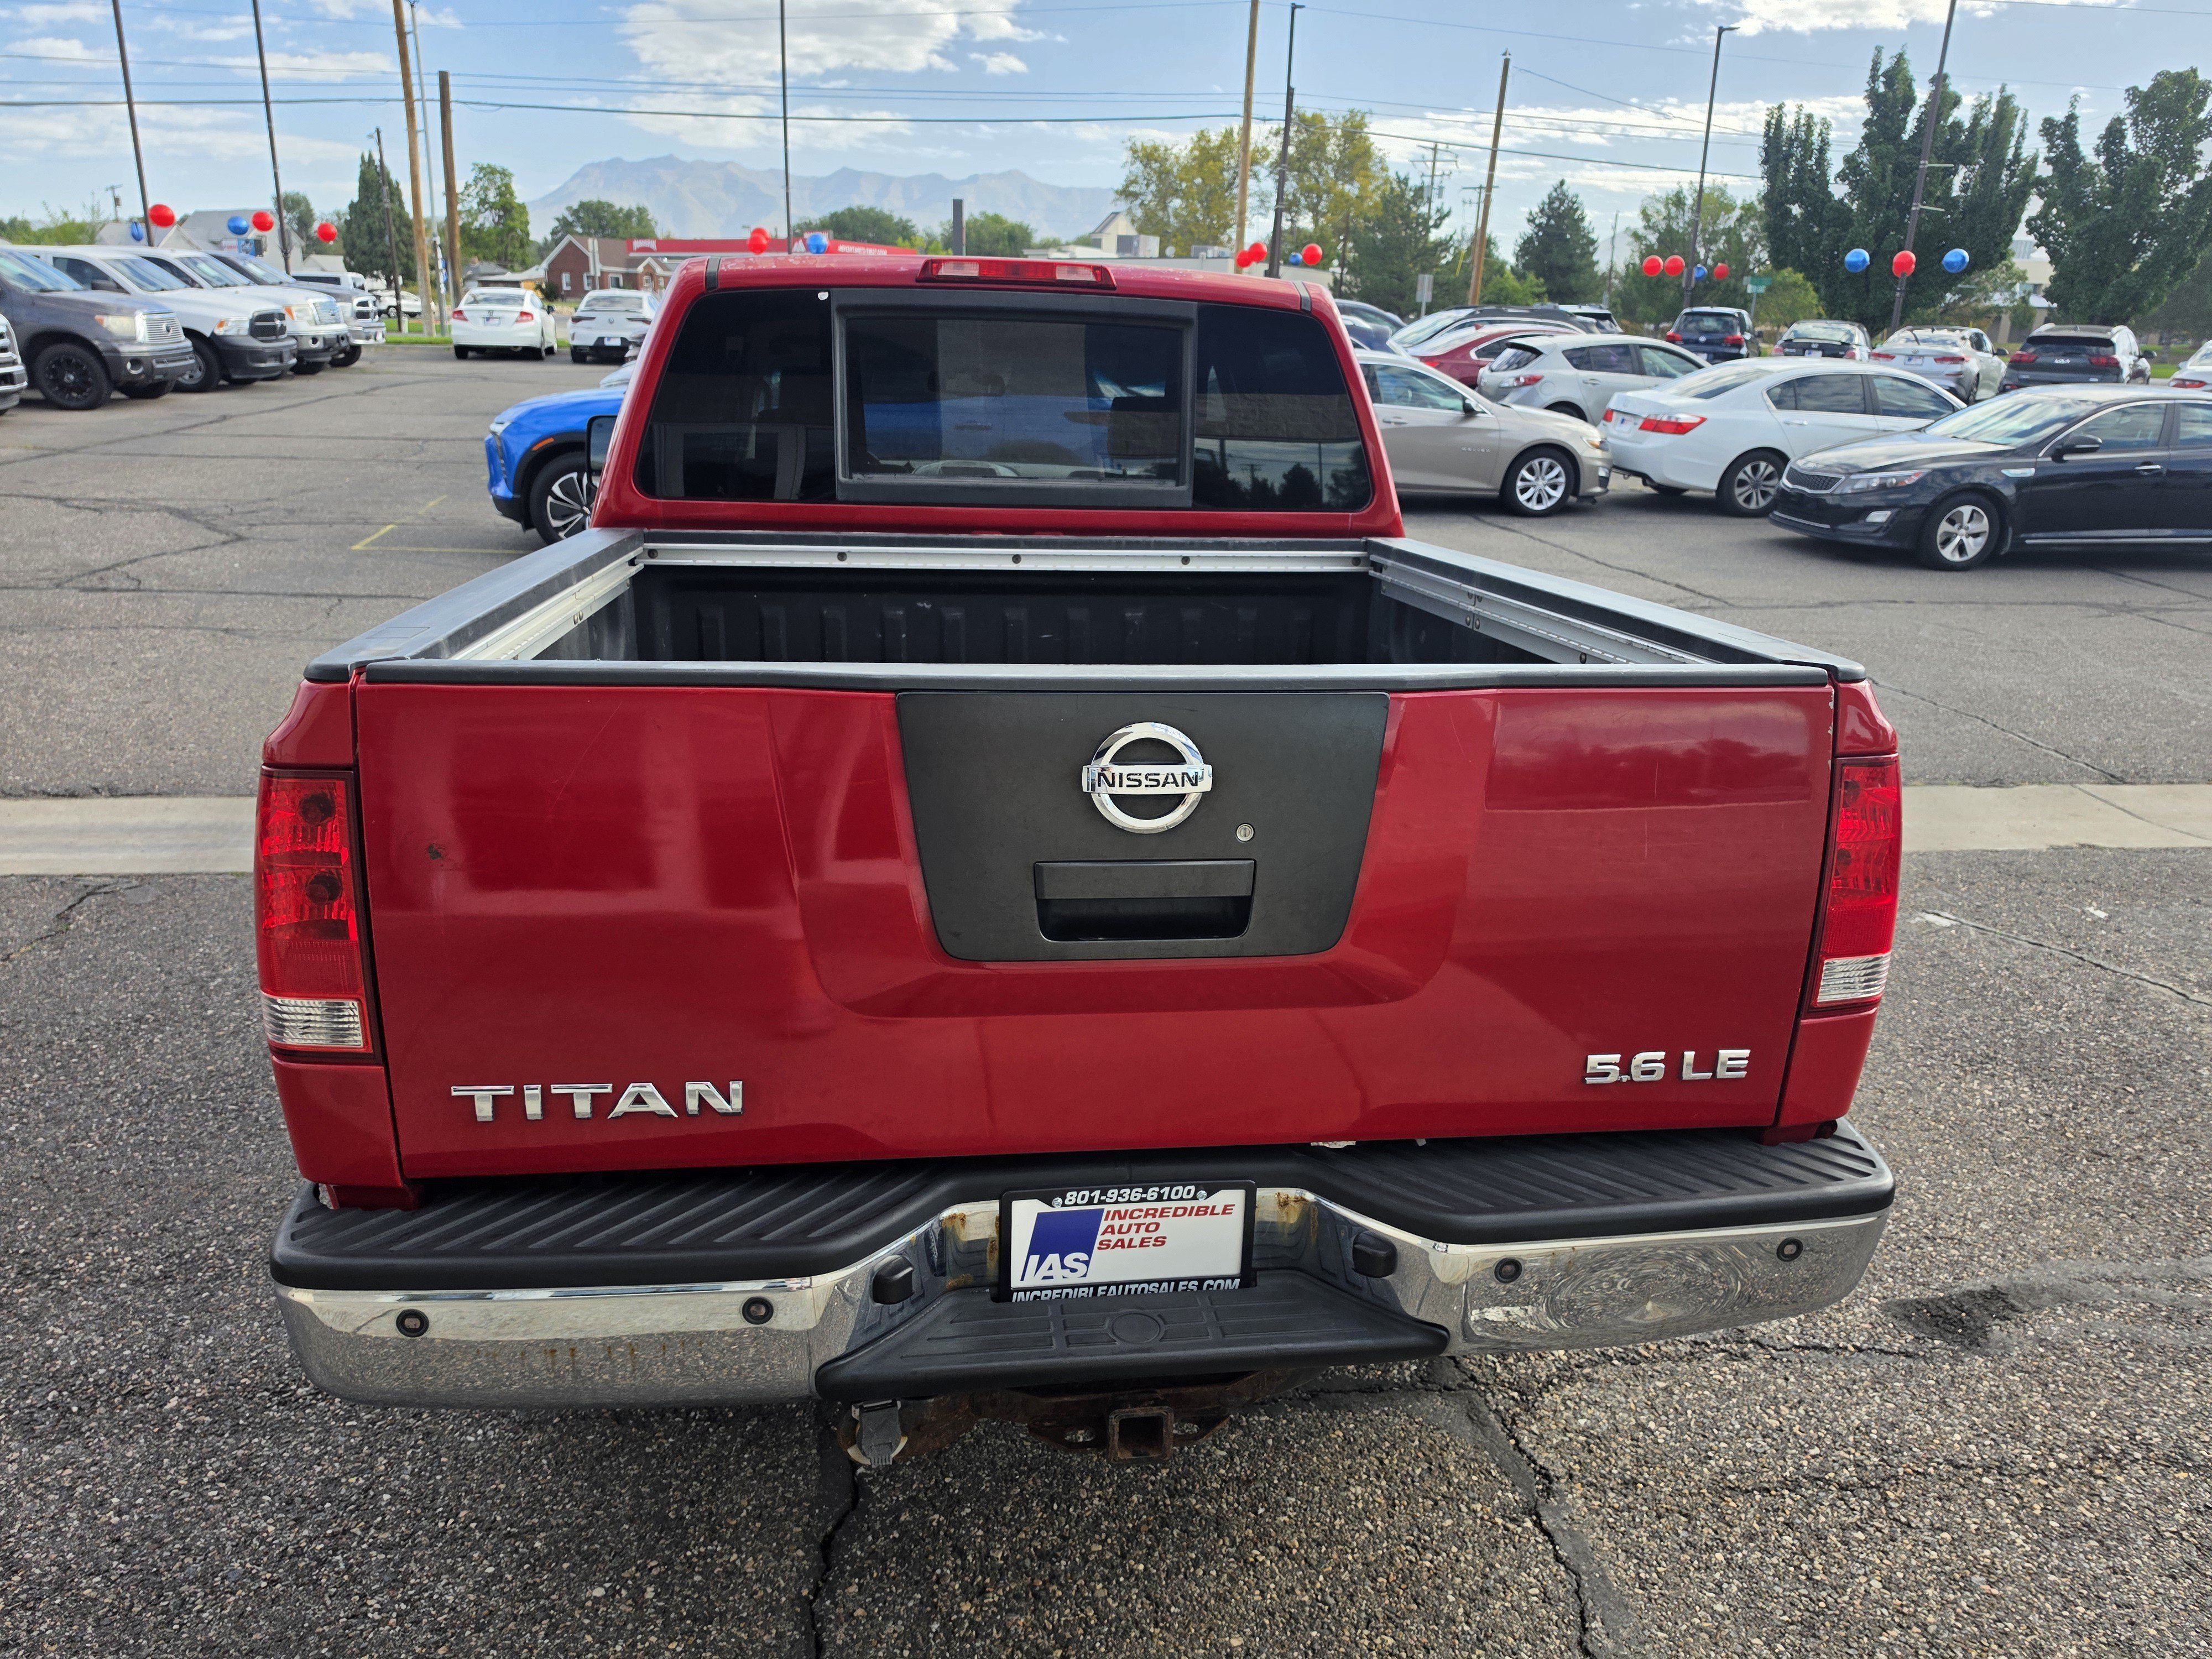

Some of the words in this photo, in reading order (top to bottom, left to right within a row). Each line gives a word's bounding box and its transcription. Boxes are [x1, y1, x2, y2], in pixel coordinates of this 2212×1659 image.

[1097, 771, 1199, 788] NISSAN
[1585, 1051, 1666, 1084] 5.6
[1682, 1050, 1751, 1081] LE
[451, 1081, 743, 1121] TITAN
[1065, 1185, 1196, 1205] 801-936-6100
[1103, 1204, 1235, 1221] INCREDIBLE
[1100, 1222, 1161, 1236] AUTO
[1097, 1235, 1167, 1250] SALES
[1024, 1252, 1089, 1281] IAS
[1011, 1279, 1240, 1303] INCREDIBLEAUTOSALESCOM
